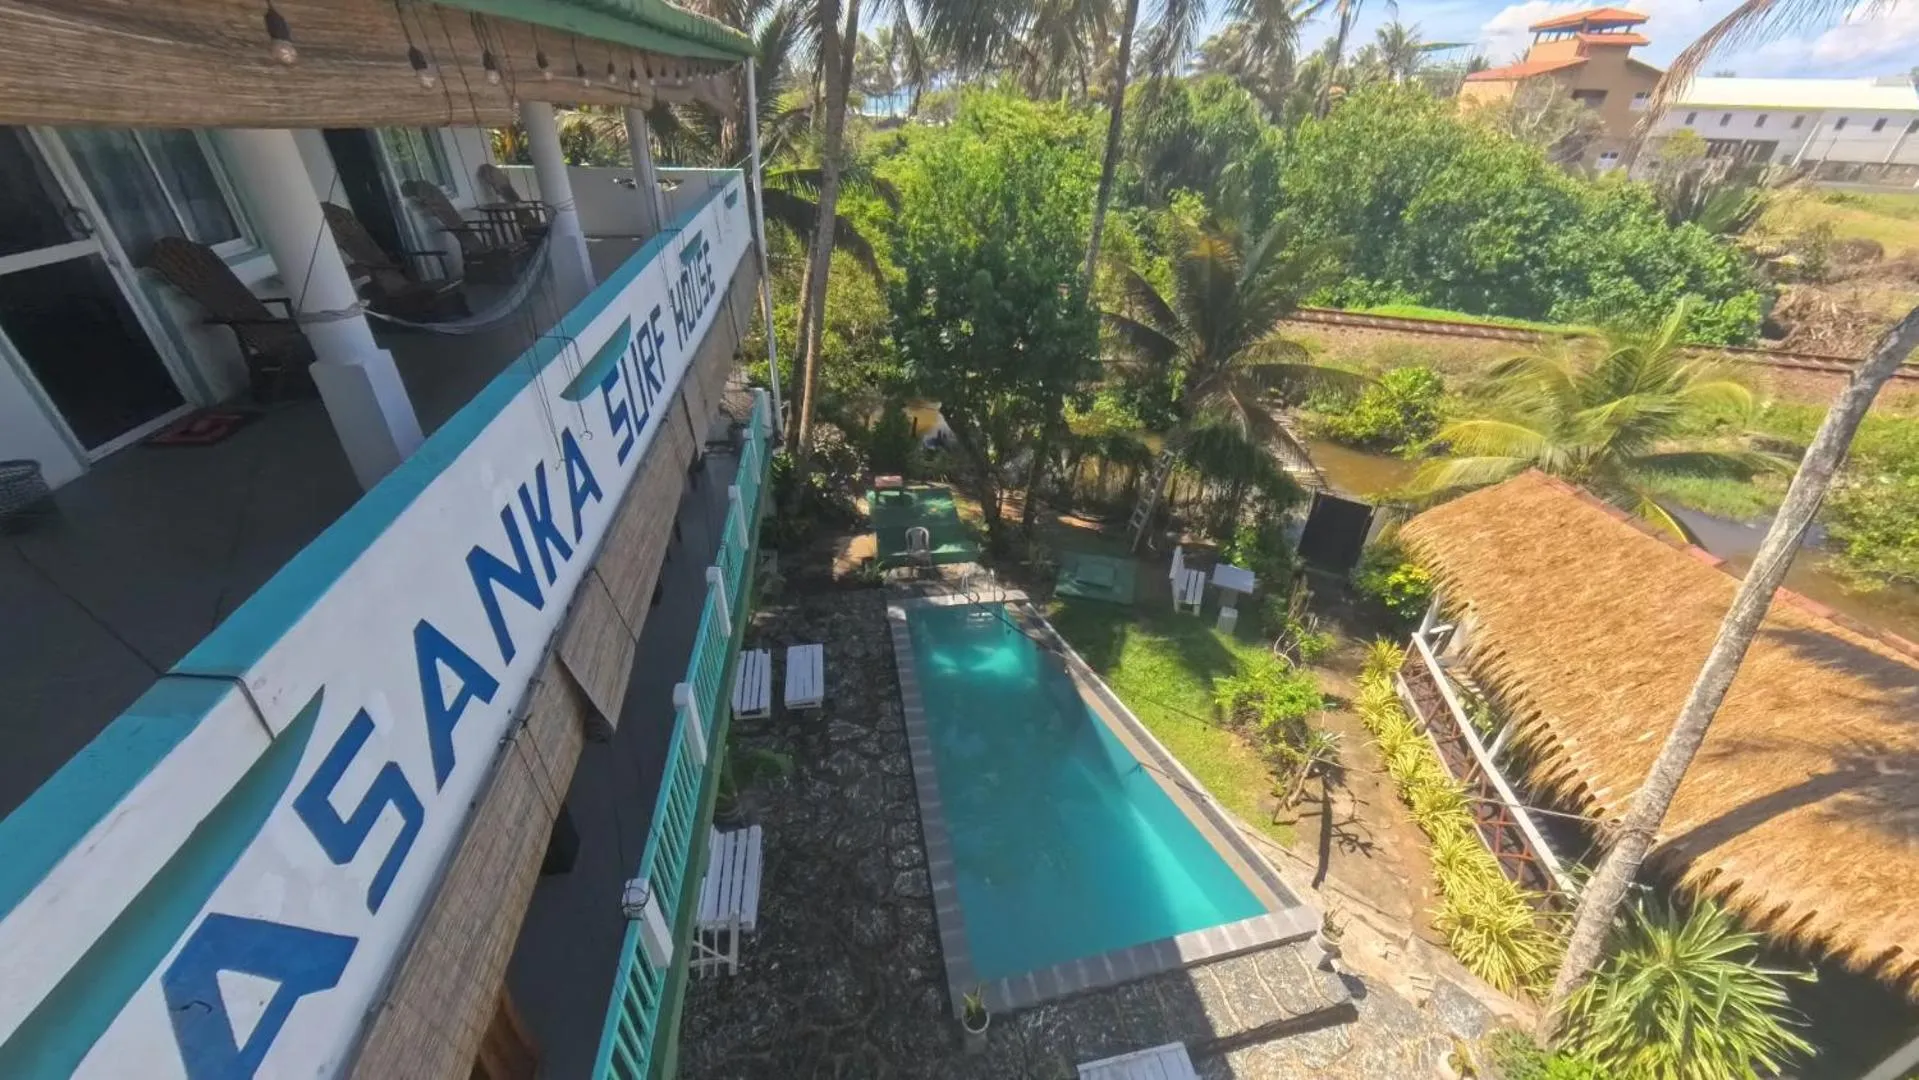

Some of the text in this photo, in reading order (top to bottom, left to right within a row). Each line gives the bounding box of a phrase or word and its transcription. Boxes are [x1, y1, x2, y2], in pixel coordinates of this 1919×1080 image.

[162, 239, 716, 1080] ASANKA SURF HOUSE
